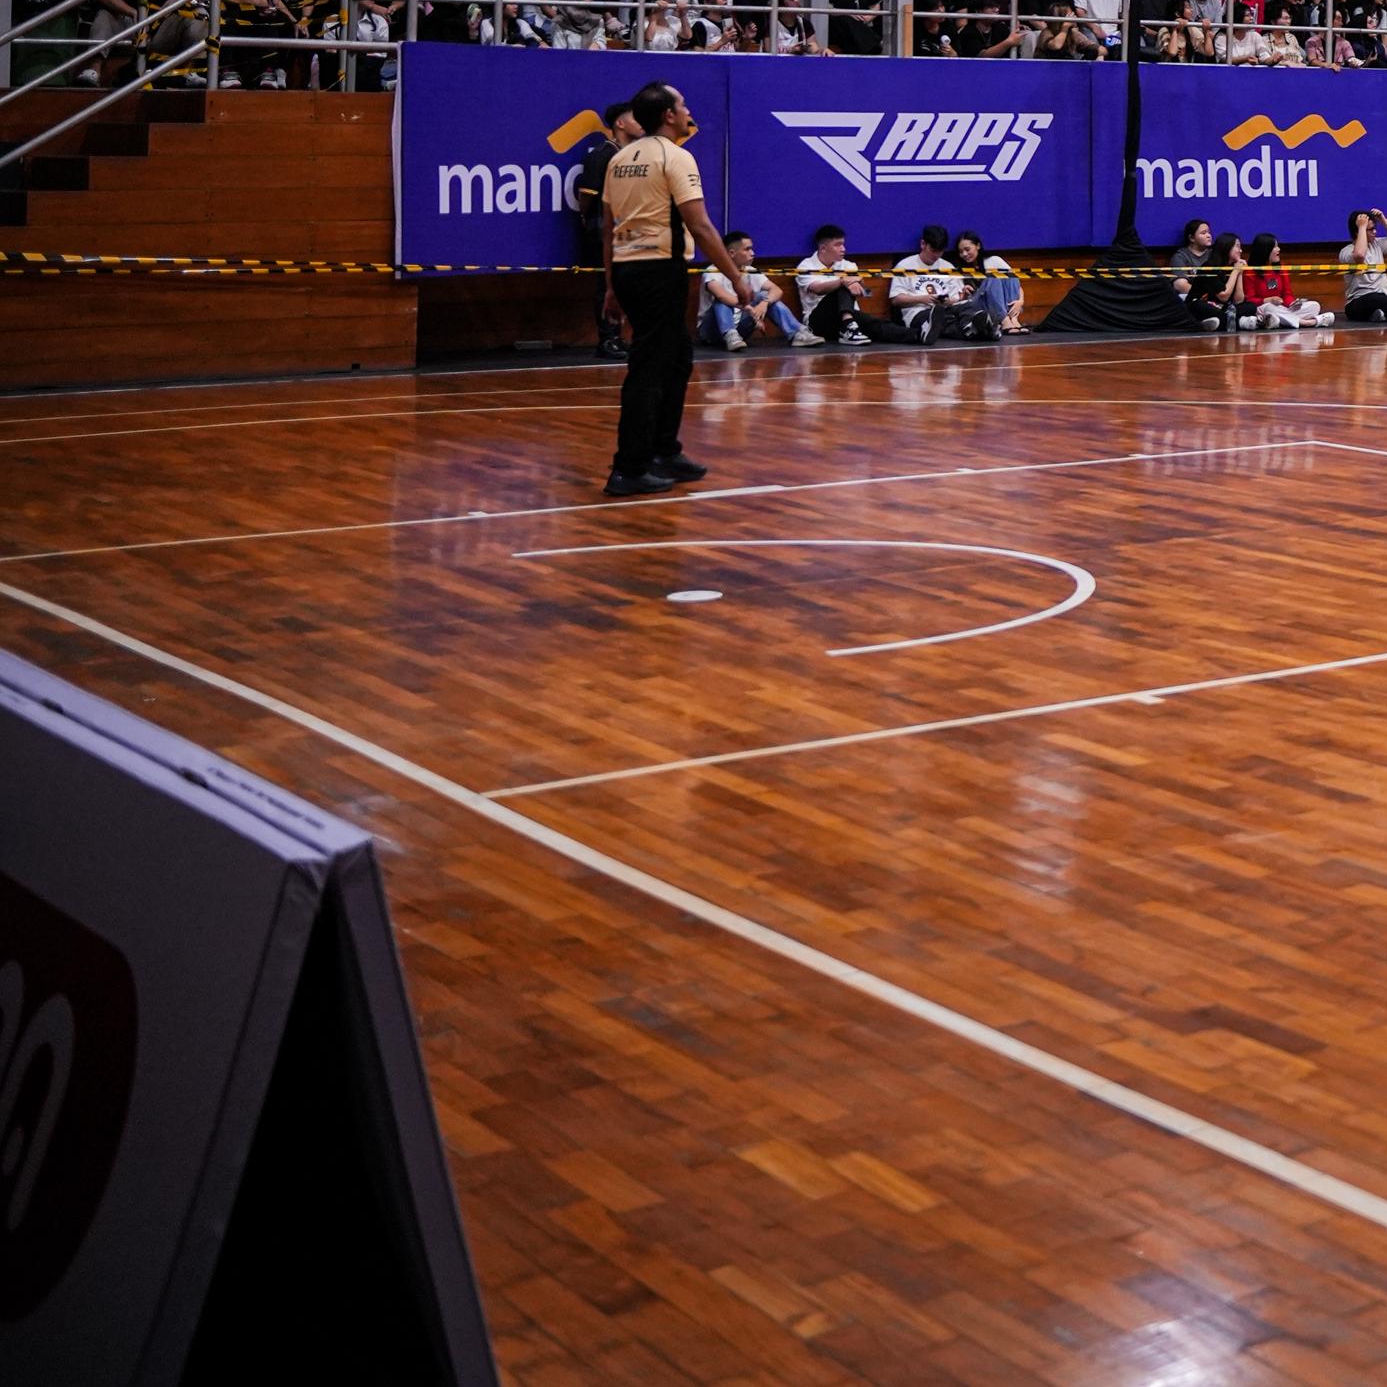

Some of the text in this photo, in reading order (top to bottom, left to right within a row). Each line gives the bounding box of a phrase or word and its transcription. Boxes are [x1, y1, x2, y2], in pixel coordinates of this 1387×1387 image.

[613, 164, 650, 179] REFEREE
[873, 112, 1054, 181] RAPS
[1123, 145, 1319, 199] mandiri
